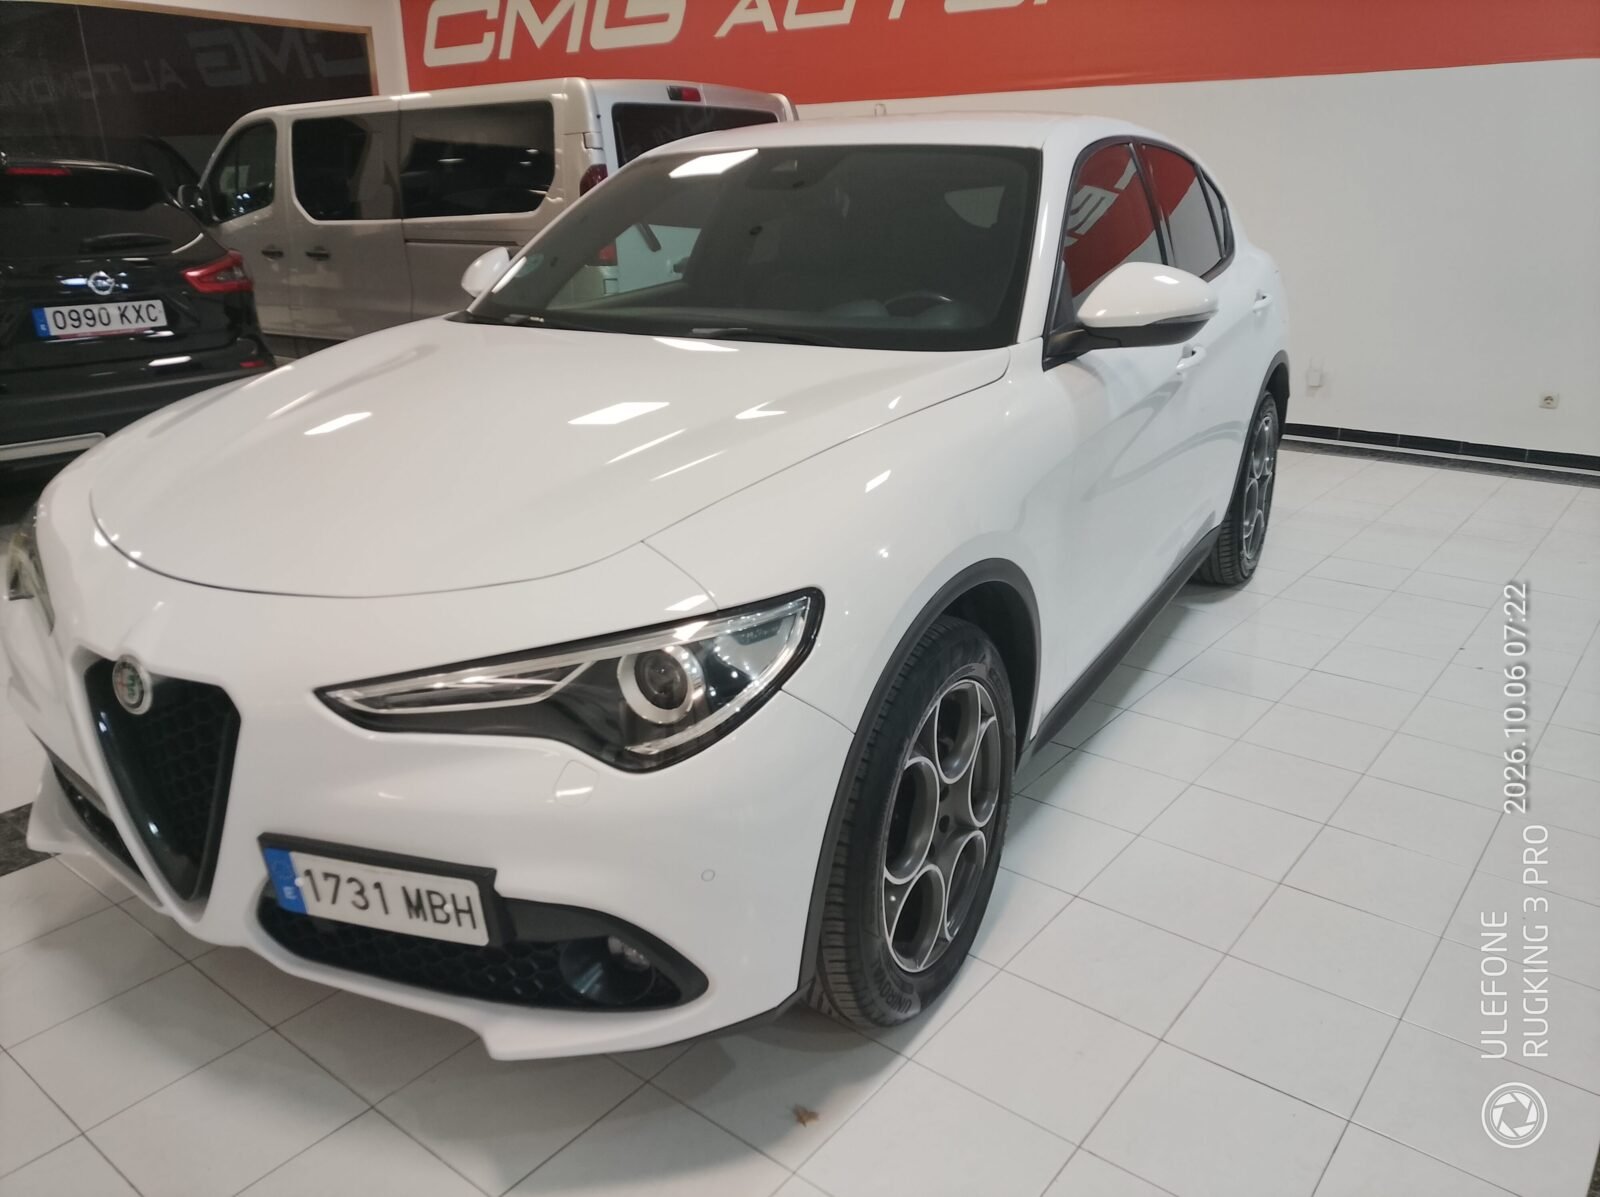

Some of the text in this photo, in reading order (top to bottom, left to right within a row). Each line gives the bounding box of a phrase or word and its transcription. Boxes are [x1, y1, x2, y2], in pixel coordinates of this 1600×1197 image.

[424, 0, 686, 67] CMG
[52, 304, 158, 330] 0990 KXC
[304, 869, 477, 930] 1731 MBH
